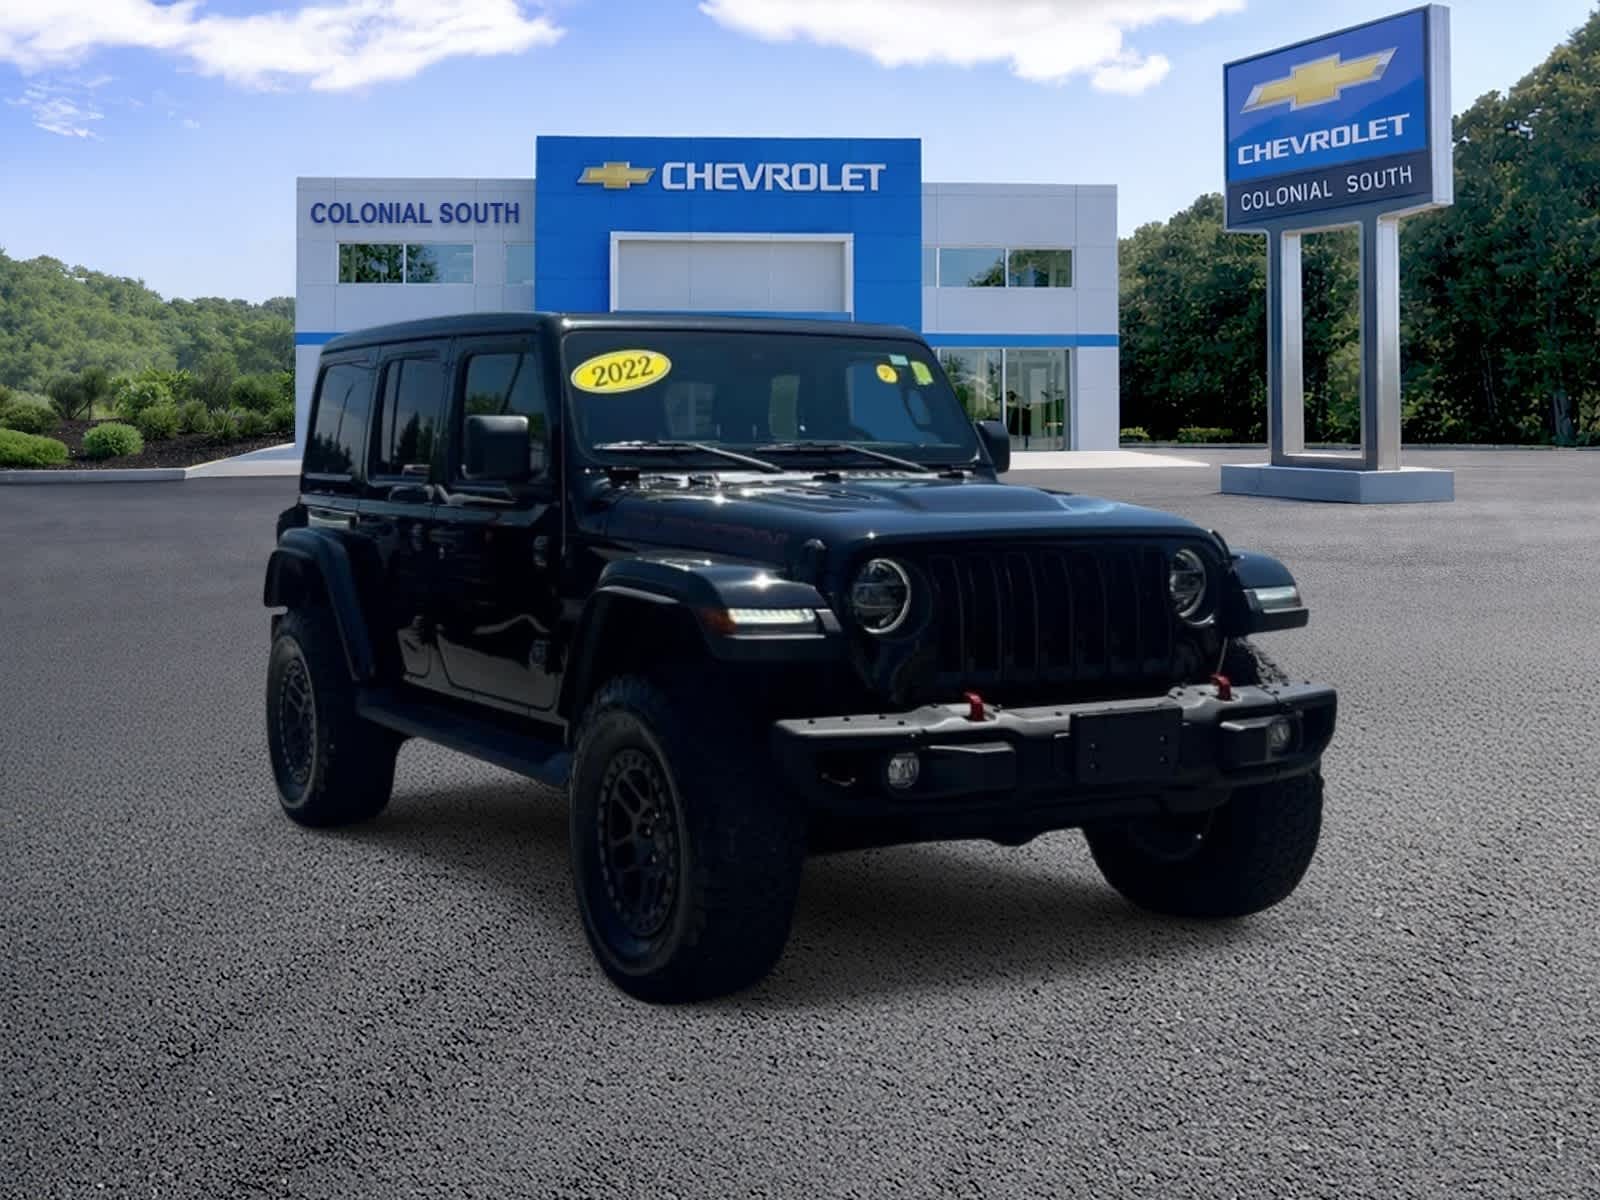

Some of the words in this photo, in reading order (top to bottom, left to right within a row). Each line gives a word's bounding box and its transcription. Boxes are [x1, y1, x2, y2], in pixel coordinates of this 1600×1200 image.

[1238, 113, 1410, 165] CHEVROLET
[662, 162, 887, 191] CHEVROLET
[1241, 181, 1333, 211] COLONIAL
[1346, 165, 1413, 194] SOUTH
[310, 202, 433, 224] COLONIAL
[438, 202, 521, 224] SOUTH
[591, 356, 655, 387] 2022
